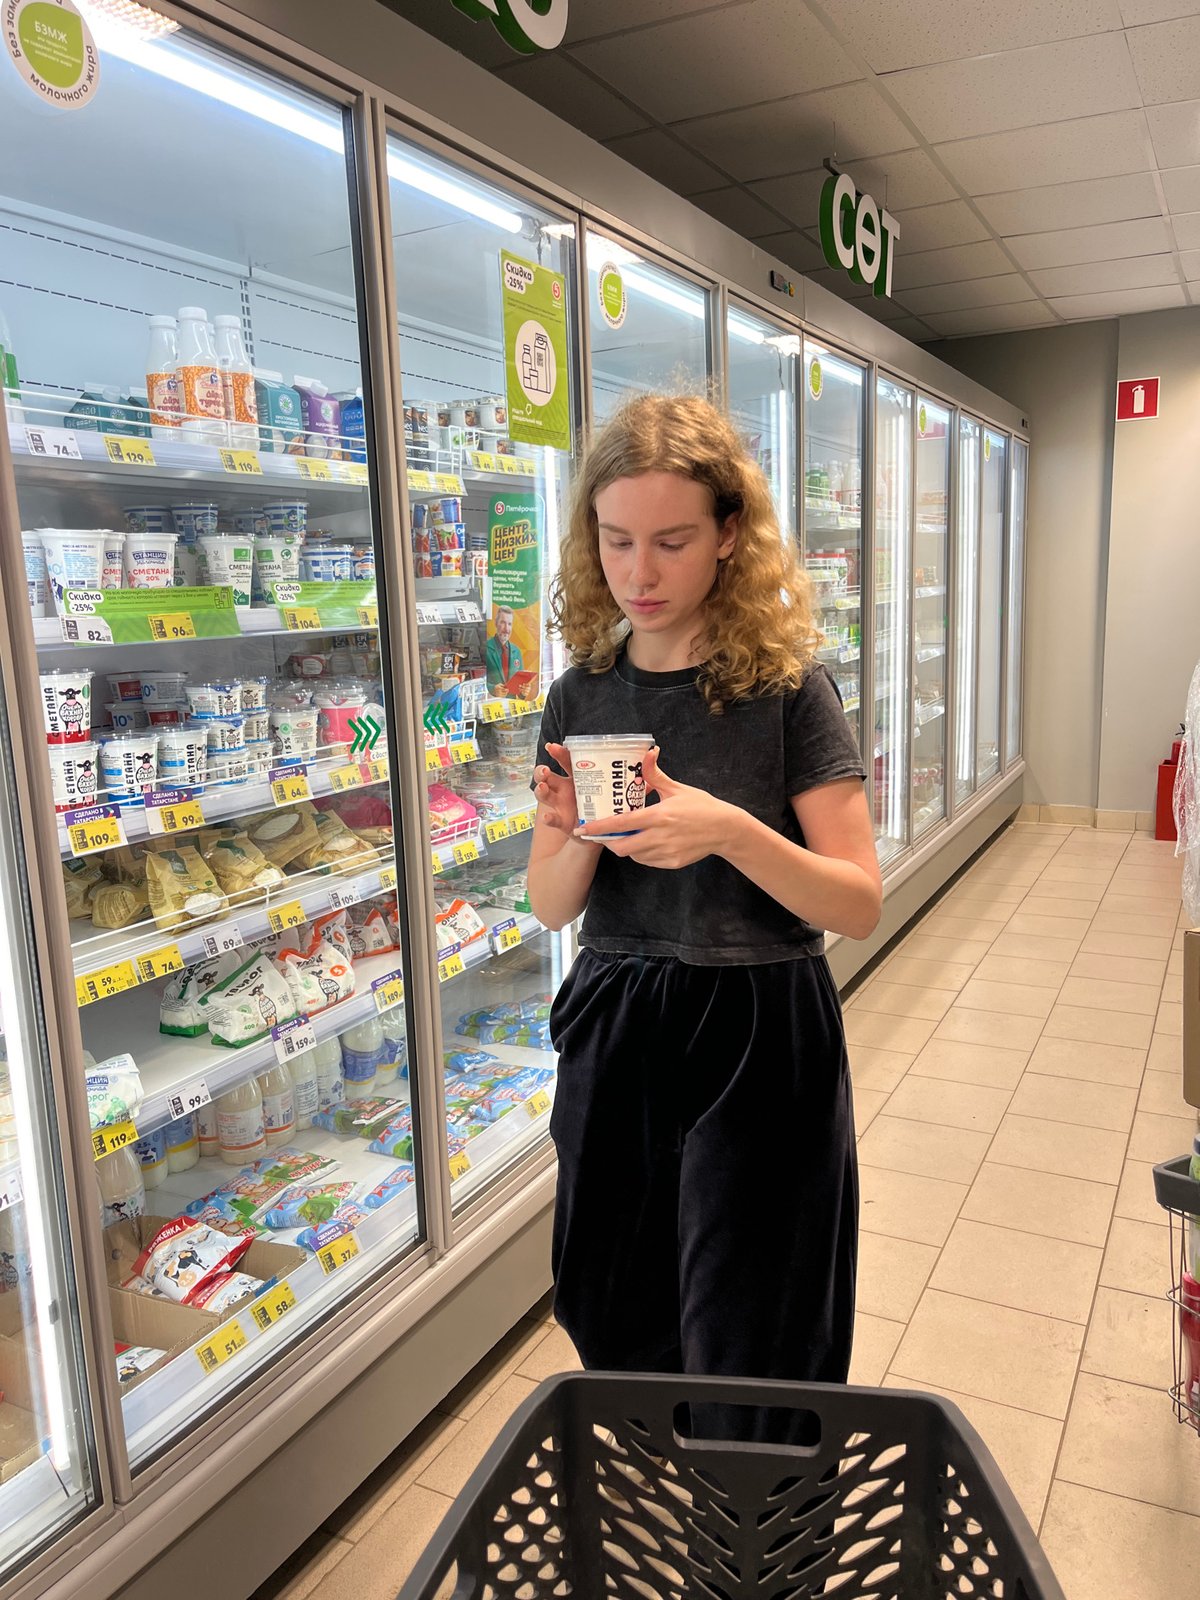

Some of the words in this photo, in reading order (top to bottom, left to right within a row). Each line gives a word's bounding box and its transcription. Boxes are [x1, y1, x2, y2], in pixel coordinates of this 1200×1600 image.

[34, 20, 68, 45] БЗМЖ
[8, 32, 22, 58] Без
[30, 73, 89, 102] молочного
[86, 45, 97, 84] жира
[506, 262, 532, 281] Скидка
[507, 276, 524, 291] -25%
[53, 444, 69, 457] 74
[126, 452, 144, 463] 129
[239, 461, 253, 472] 119
[494, 523, 529, 539] ЦЕНТР
[494, 533, 537, 550] НИЗКИХ
[134, 552, 167, 560] СТАНЦИЯ
[494, 548, 515, 561] ЦЕН
[133, 568, 170, 576] СМЕТАНА
[275, 584, 300, 592] Скидка
[68, 592, 102, 601] Скидка
[279, 593, 295, 601] -25%
[71, 603, 94, 612] -25%
[425, 614, 437, 623] 104
[299, 620, 314, 629] 104
[87, 630, 102, 642] 82
[172, 626, 186, 637] 96
[291, 788, 302, 798] 64
[151, 797, 179, 805] ТАТАРСТАНЕ
[74, 809, 100, 818] СДЕЛАНО
[182, 815, 195, 826] 99
[89, 833, 109, 846] 109
[341, 895, 354, 905] 109
[288, 915, 298, 925] 99
[222, 939, 235, 949] 89
[161, 961, 175, 973] 74
[101, 976, 112, 987] 59
[224, 966, 263, 998] ТВОРОГ
[106, 986, 115, 995] 69
[295, 1037, 309, 1049] 159
[188, 1095, 201, 1108] 99
[110, 1132, 127, 1148] 119
[340, 1249, 351, 1262] 37
[275, 1301, 289, 1315] 58
[224, 1339, 238, 1355] 51
